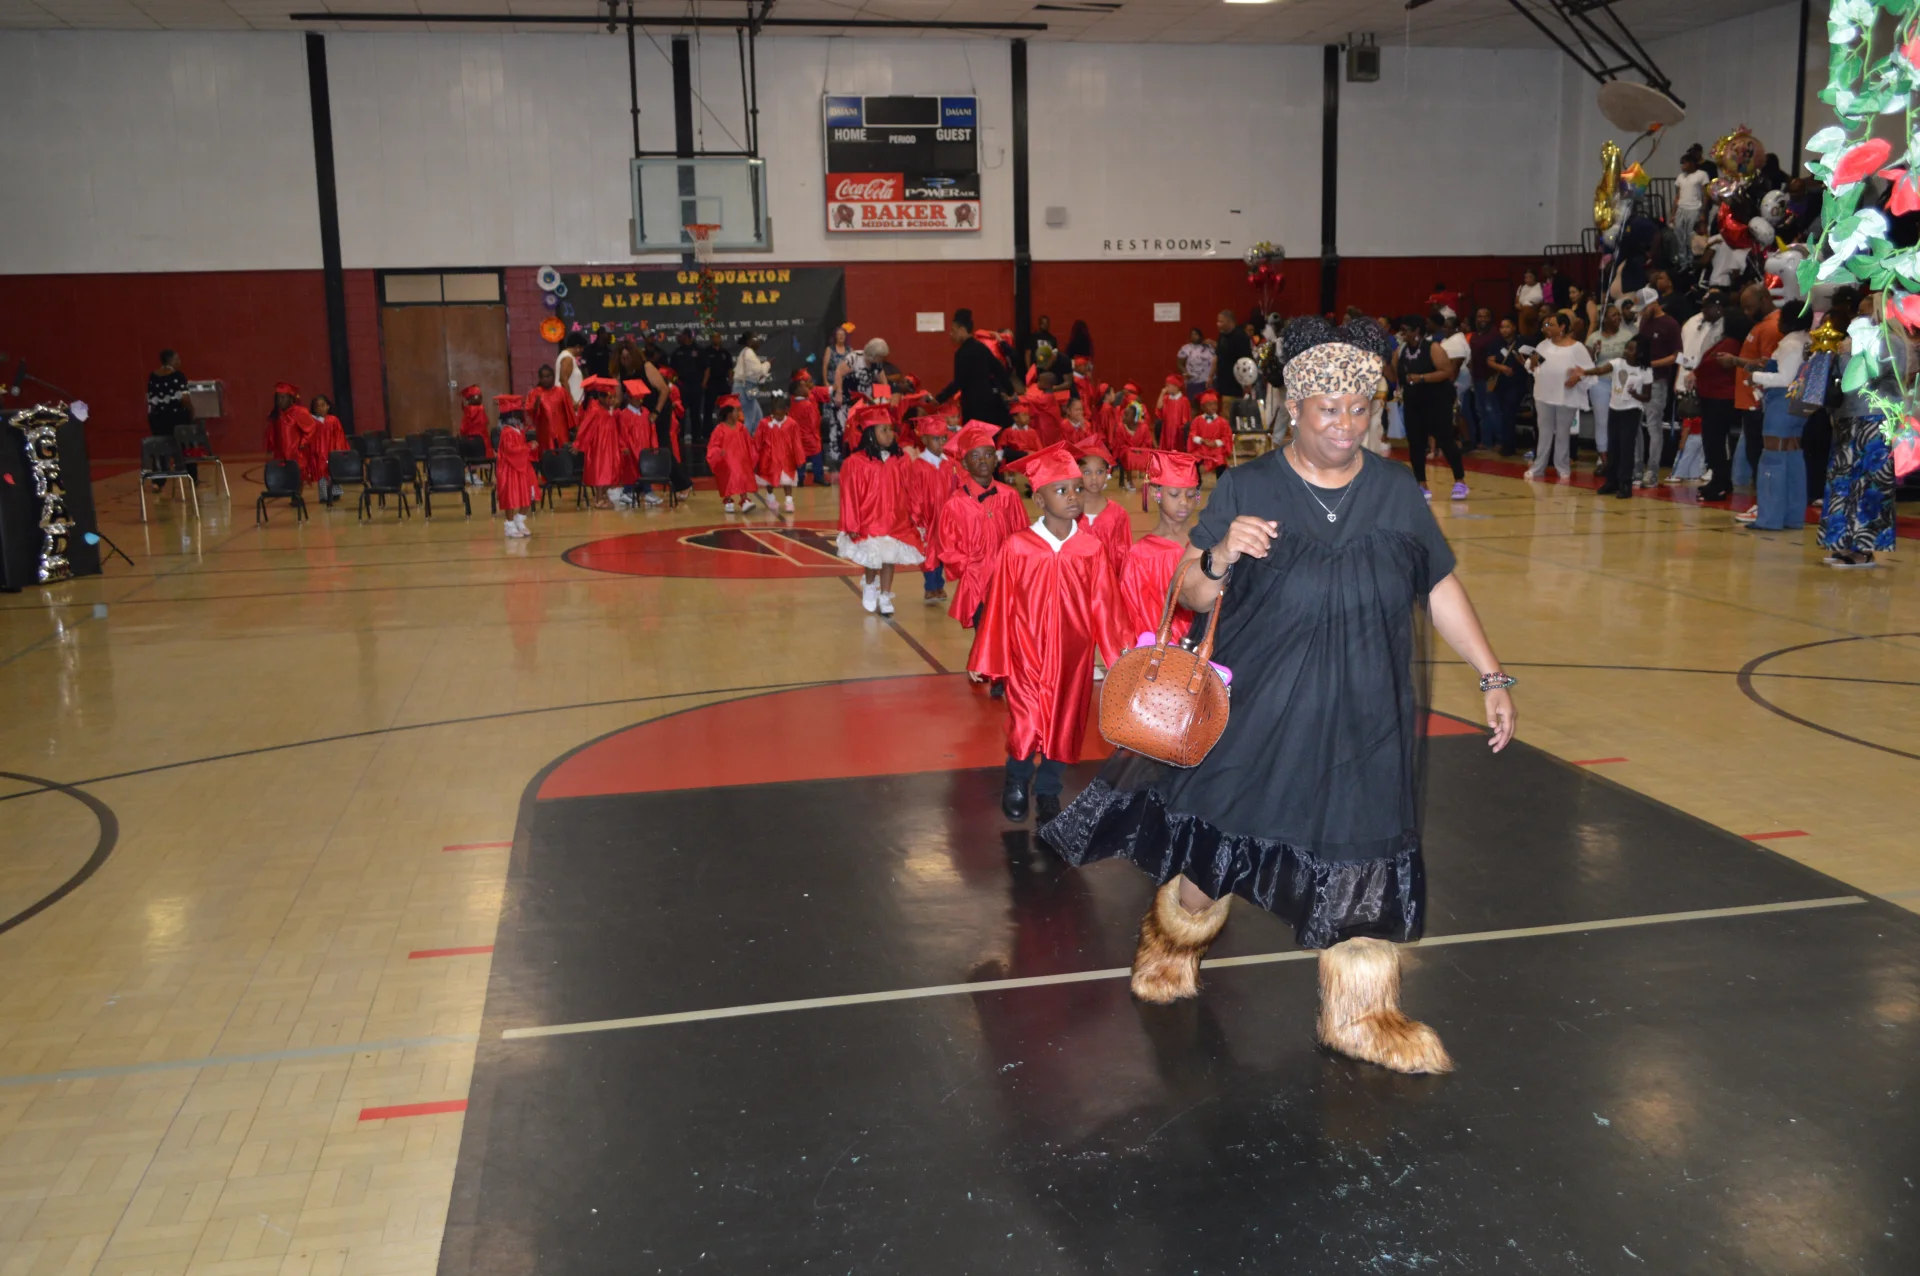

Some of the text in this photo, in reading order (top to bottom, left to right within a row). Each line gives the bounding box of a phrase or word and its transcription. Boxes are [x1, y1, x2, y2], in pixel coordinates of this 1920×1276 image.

[834, 128, 867, 141] HOME
[888, 135, 917, 144] PERIOD
[936, 128, 972, 141] GUEST
[861, 204, 947, 220] BAKER
[861, 220, 948, 228] MIDDLE SCHOOL
[1104, 239, 1212, 250] RESTROOMS
[580, 269, 790, 287] PRE-K GRDUATION
[742, 290, 781, 304] RAP
